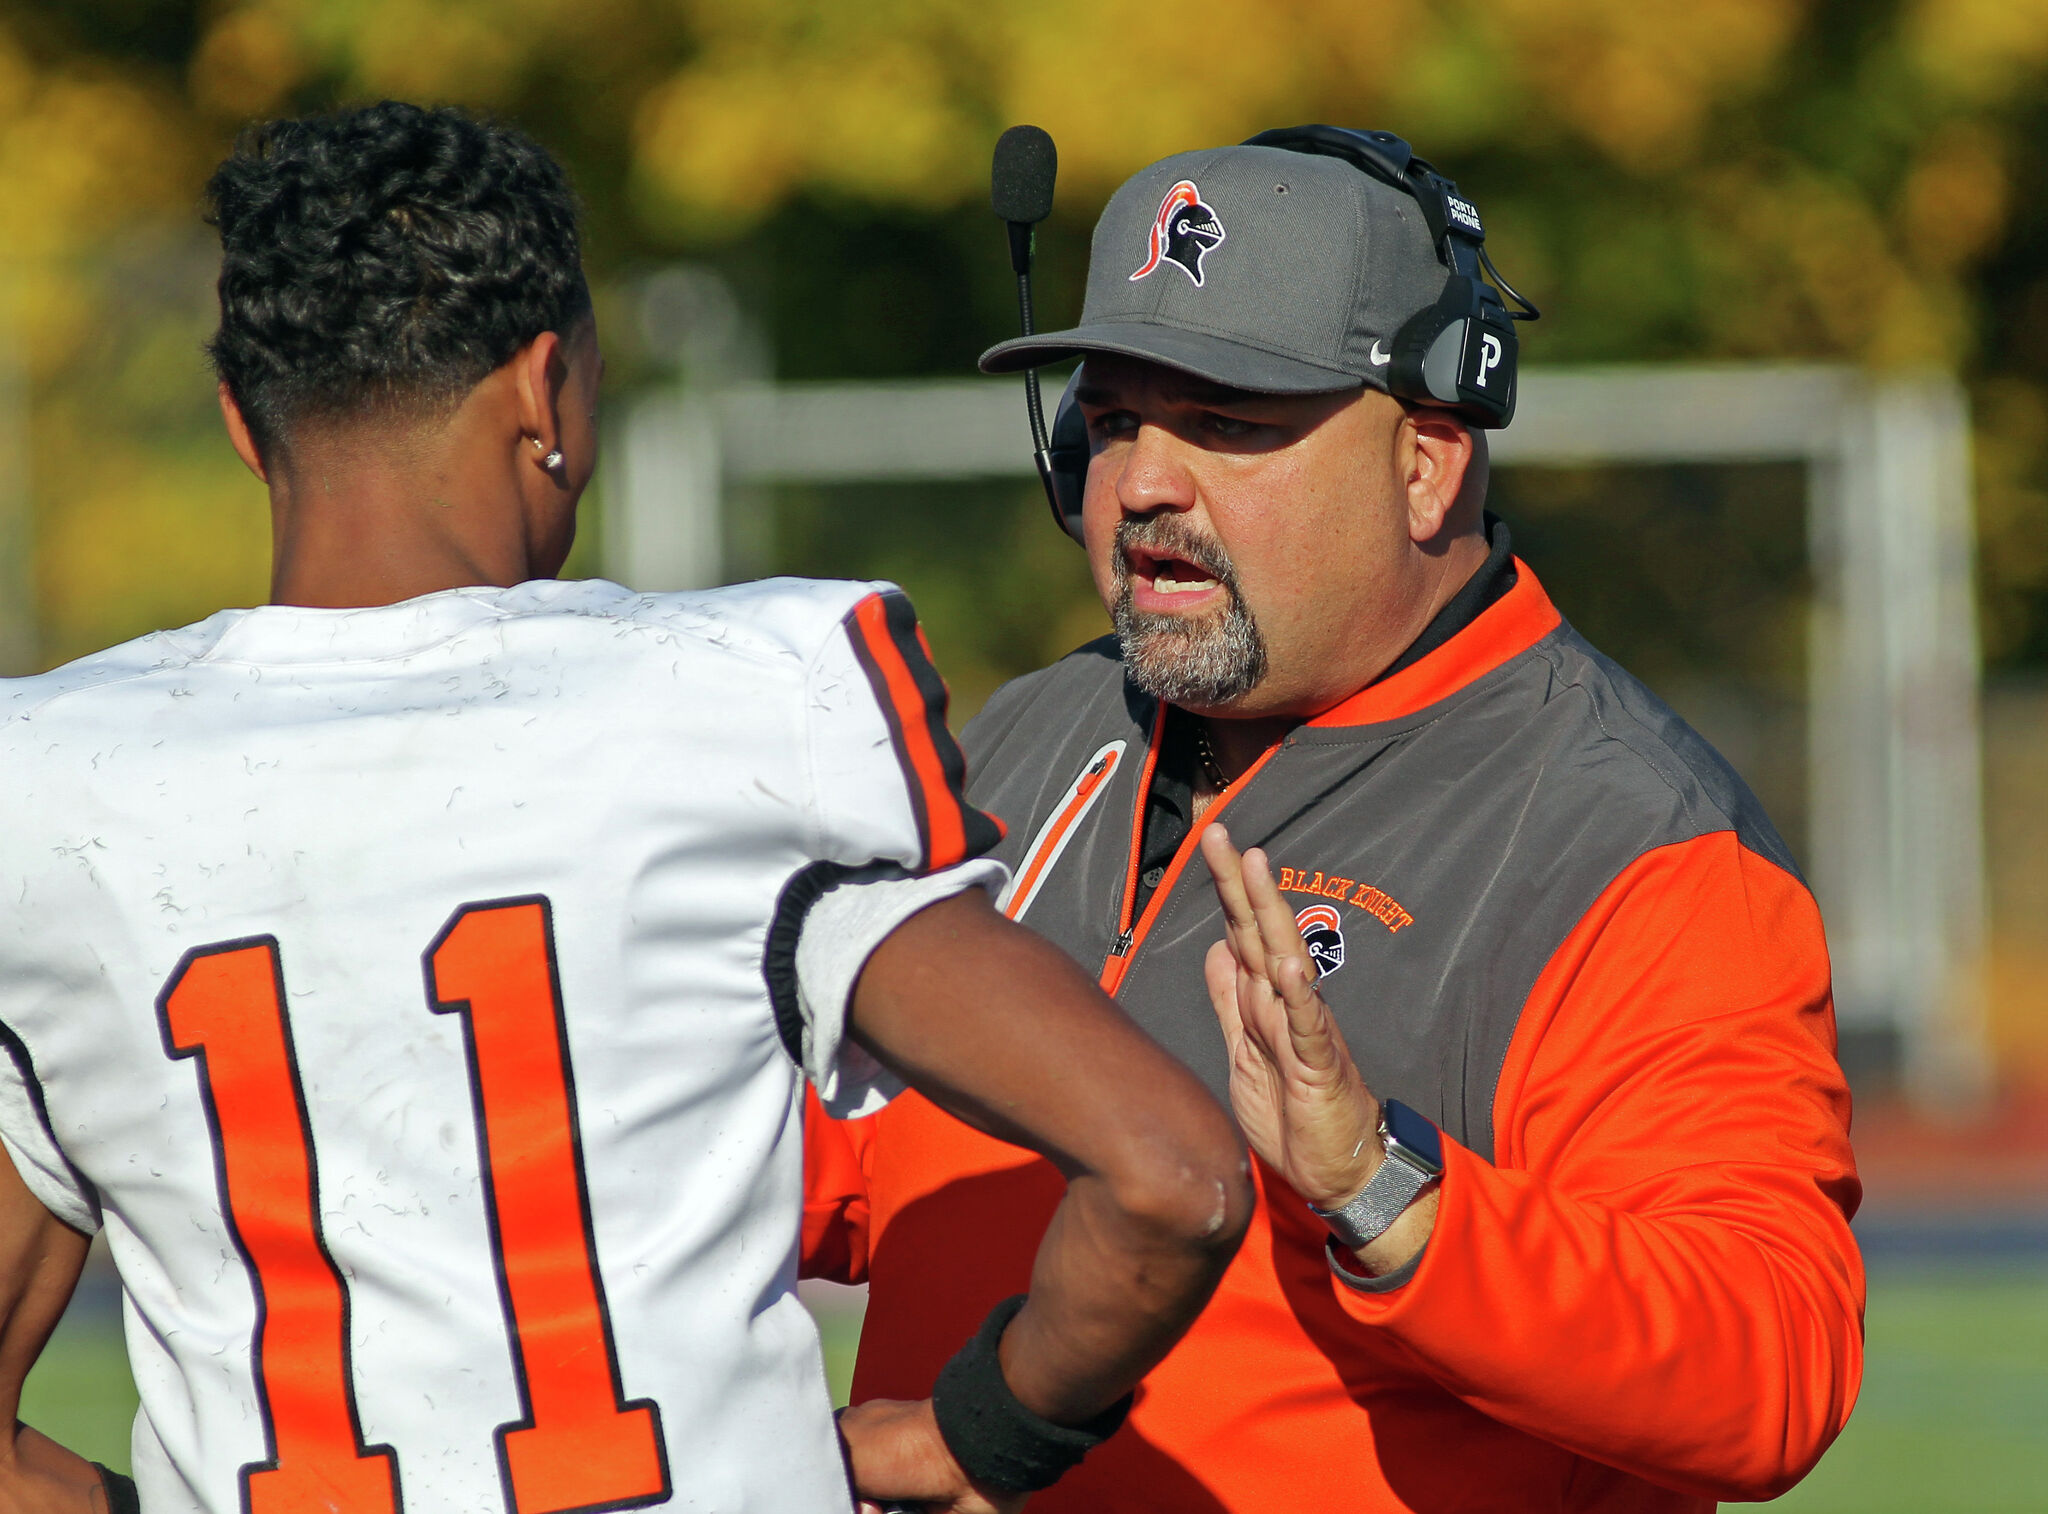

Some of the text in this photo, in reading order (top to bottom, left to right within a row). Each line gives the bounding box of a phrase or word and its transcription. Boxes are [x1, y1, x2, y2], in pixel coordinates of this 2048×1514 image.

[1447, 195, 1478, 218] PORTA
[1450, 207, 1482, 231] PHONE
[1278, 867, 1415, 935] BLACK KNIGHT
[154, 893, 673, 1514] 11
